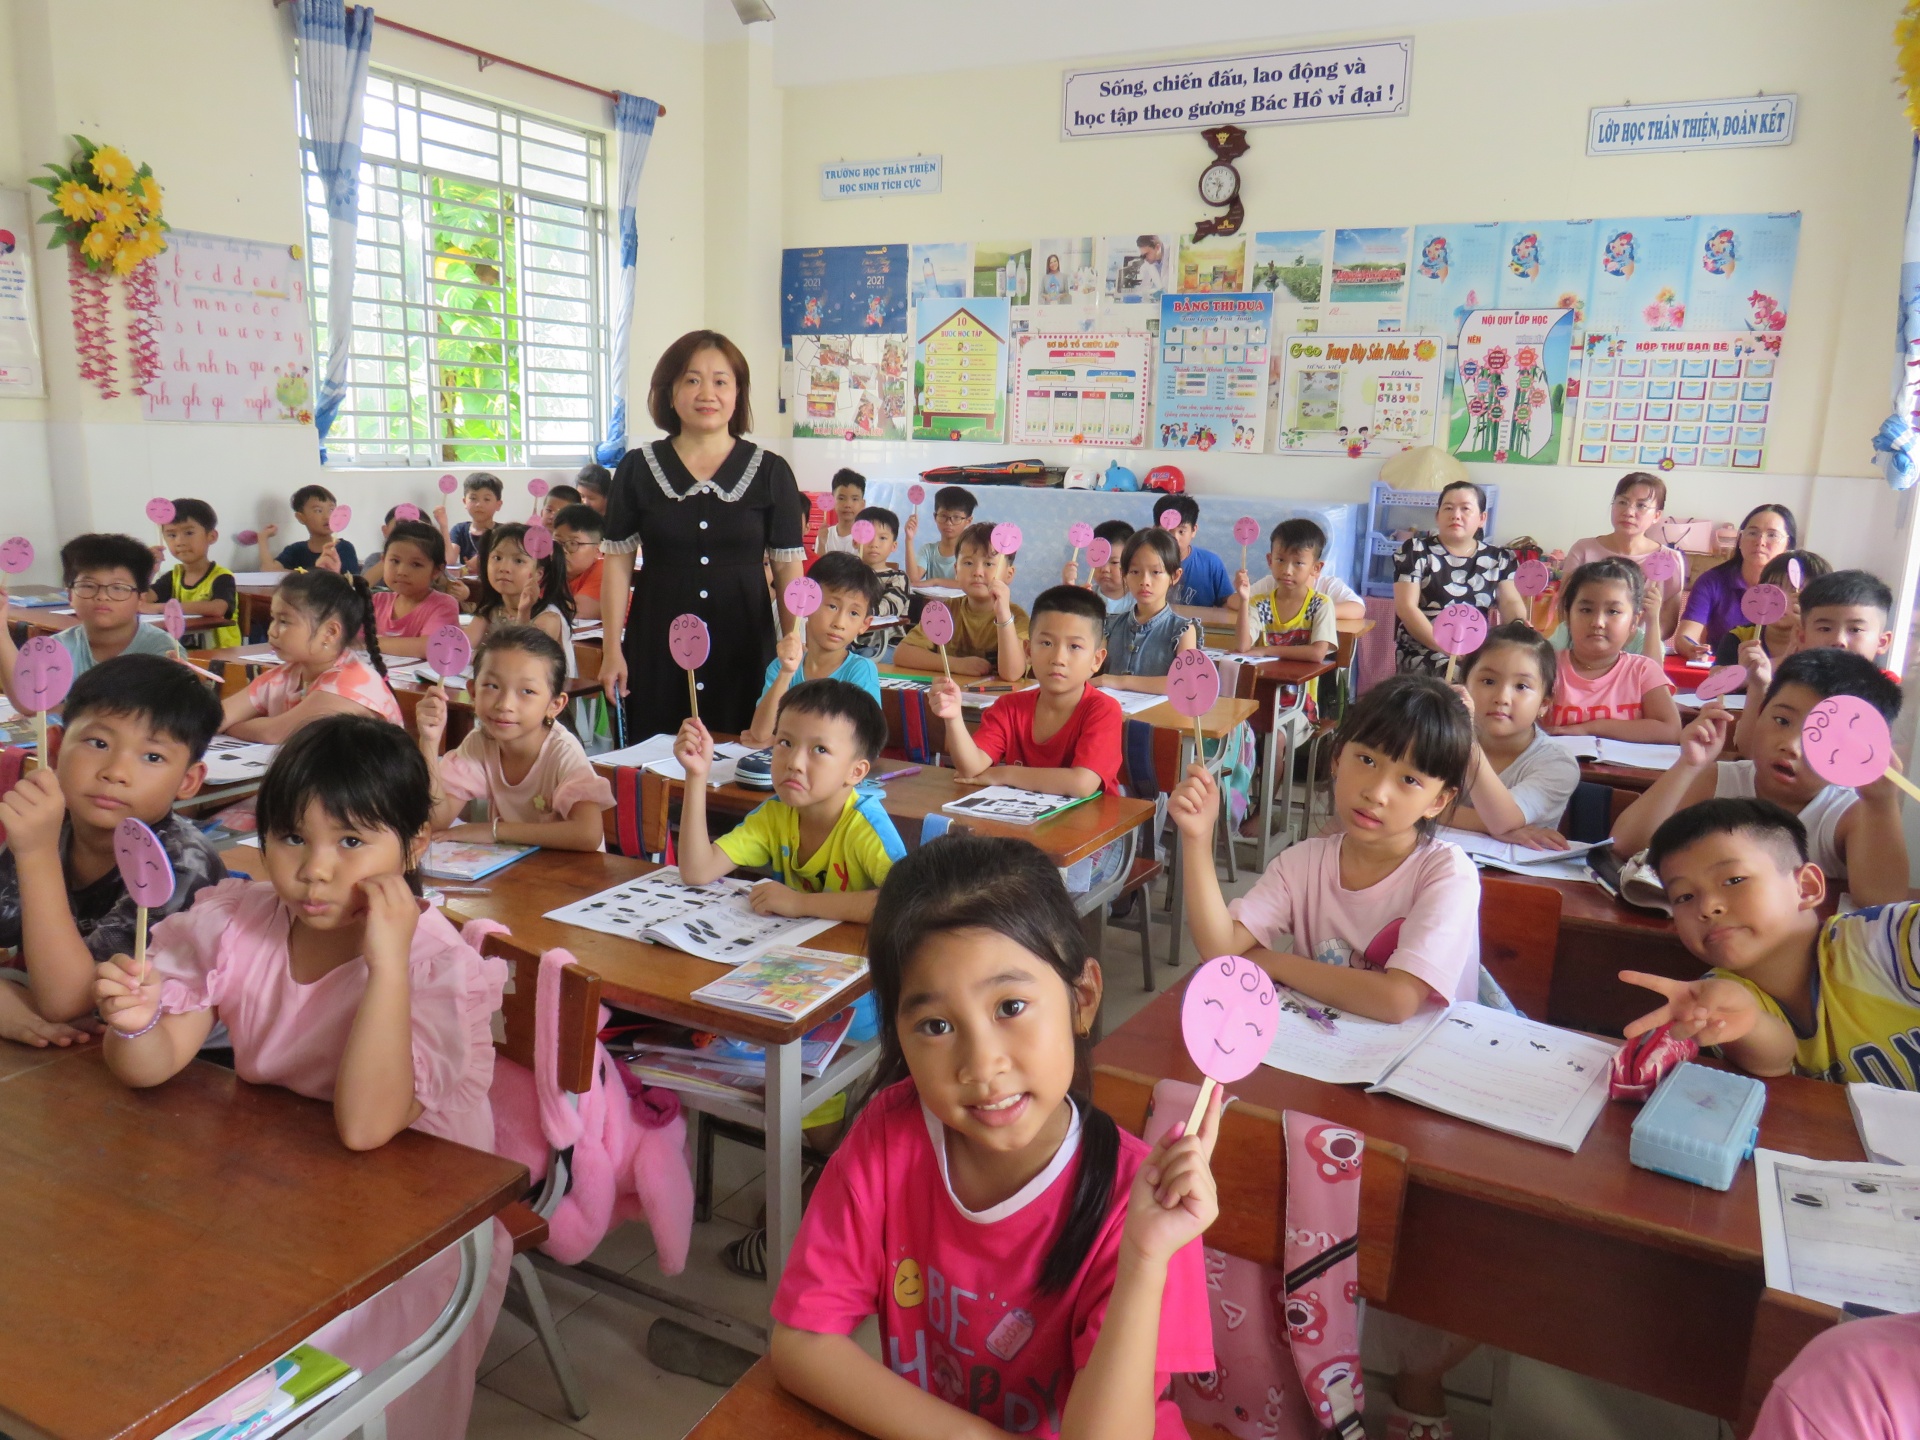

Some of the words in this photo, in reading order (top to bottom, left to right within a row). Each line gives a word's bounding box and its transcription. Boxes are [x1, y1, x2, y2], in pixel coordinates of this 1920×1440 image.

[1099, 77, 1148, 97] Sống,
[1153, 71, 1203, 92] chiến
[1208, 67, 1247, 90] đấu,
[1253, 66, 1283, 84] lao
[1288, 60, 1339, 83] động
[1343, 57, 1367, 75] và
[1073, 109, 1105, 128] học
[1110, 101, 1139, 125] tập
[1143, 105, 1184, 122] theo
[1187, 97, 1246, 120] gương
[1250, 93, 1288, 112] Bác
[1292, 87, 1323, 109] Hồ
[1350, 85, 1384, 107] đại
[1598, 117, 1620, 144] LỚP
[1621, 121, 1646, 146] HỌC
[1647, 114, 1681, 141] THÂN
[1682, 111, 1720, 142] THIỆN,
[1759, 103, 1786, 134] KẾT
[863, 167, 881, 178] HỌC
[883, 164, 907, 176] THÂN
[909, 161, 936, 175] THIỆN
[839, 184, 857, 194] HỌC
[859, 181, 880, 192] SINH
[881, 179, 902, 191] TÍCH
[904, 178, 922, 190] CỰC
[866, 276, 885, 286] 2021
[1174, 297, 1210, 312] BẢNG
[1212, 301, 1235, 312] THI
[956, 317, 967, 327] 10
[1481, 314, 1495, 327] NỘI
[1497, 315, 1513, 326] QUY
[1515, 314, 1530, 325] LỚP
[1531, 315, 1548, 326] HỌC
[1467, 334, 1482, 344] NÊN
[1404, 383, 1412, 391] 4
[927, 1264, 978, 1357] BE
